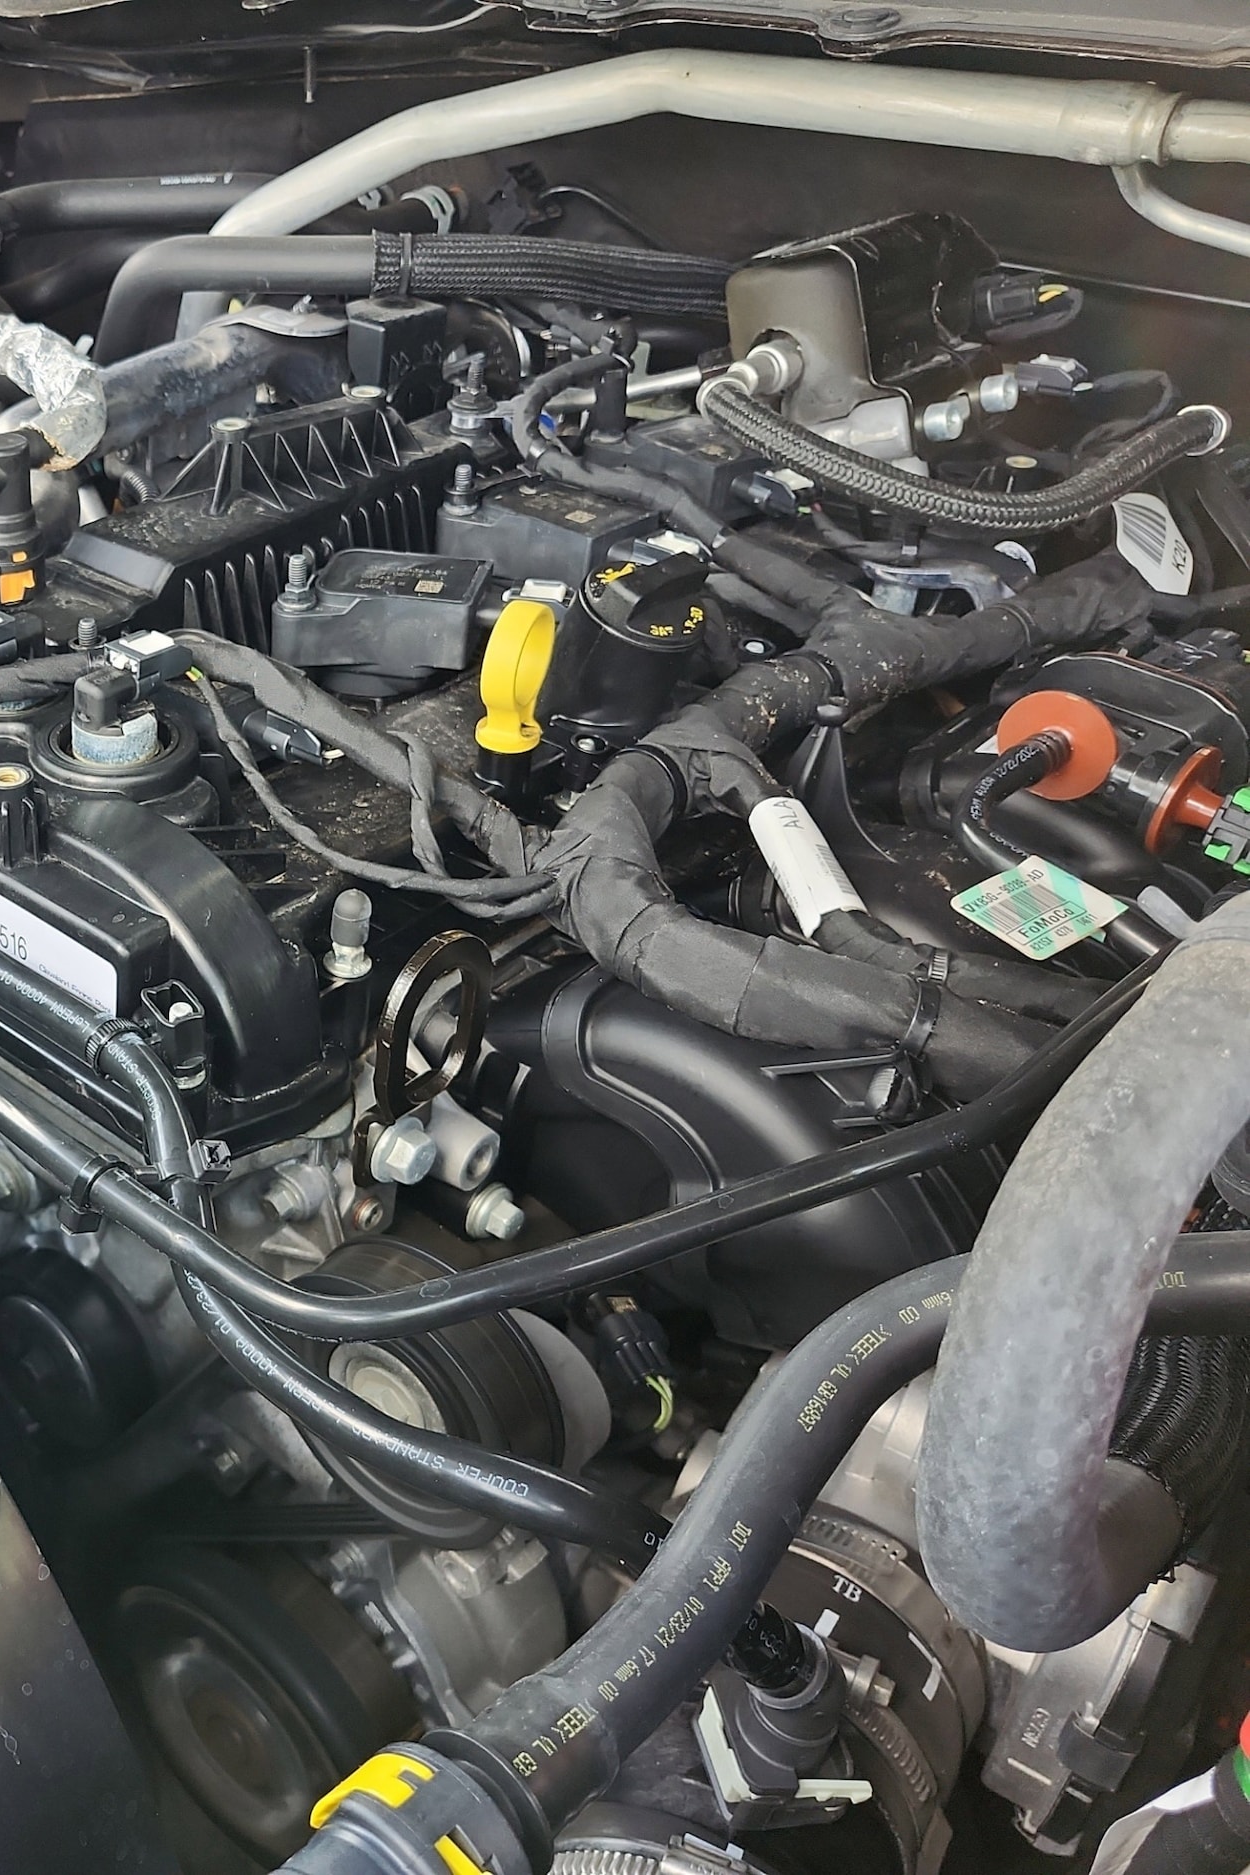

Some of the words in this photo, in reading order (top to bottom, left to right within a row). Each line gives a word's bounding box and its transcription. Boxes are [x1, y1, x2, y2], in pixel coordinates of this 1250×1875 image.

[1172, 539, 1187, 575] K20
[773, 800, 805, 829] ALA
[1017, 908, 1075, 939] FoMoCo
[0, 924, 28, 961] 516
[16, 980, 47, 1005] 4000A
[50, 1000, 90, 1033] LoPERM
[235, 1337, 278, 1376] 4000A
[797, 1380, 838, 1432] GB16897
[456, 1461, 529, 1498] COOPER
[728, 1520, 752, 1552] DOT
[832, 1574, 862, 1603] TB
[654, 1596, 705, 1648] 01/23/21
[614, 1645, 657, 1683] 17.6mm
